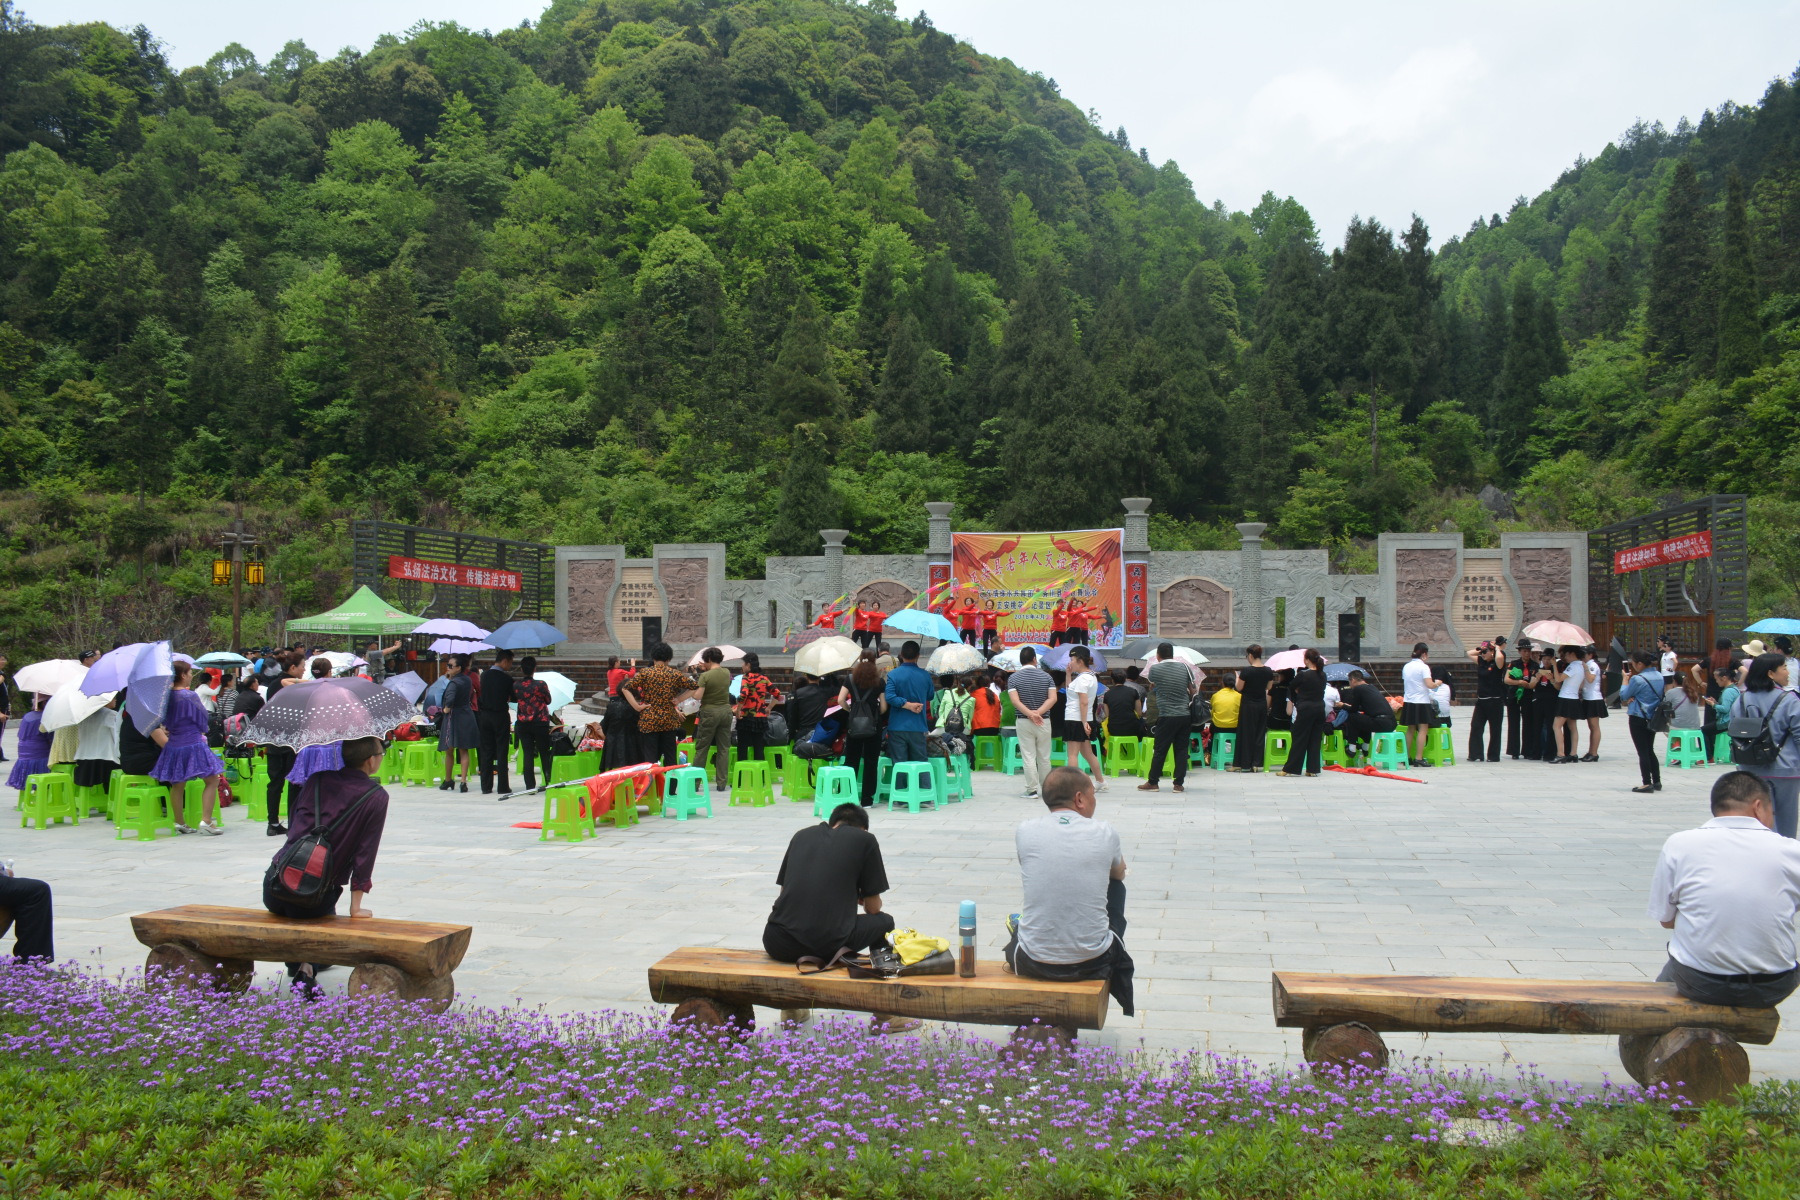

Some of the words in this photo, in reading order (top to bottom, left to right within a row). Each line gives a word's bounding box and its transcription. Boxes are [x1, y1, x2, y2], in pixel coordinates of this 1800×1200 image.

[404, 561, 457, 583] 弘扬法治文化
[466, 569, 516, 588] 传播法治文明
[970, 549, 1106, 586] 正安县老年人交谊舞协会
